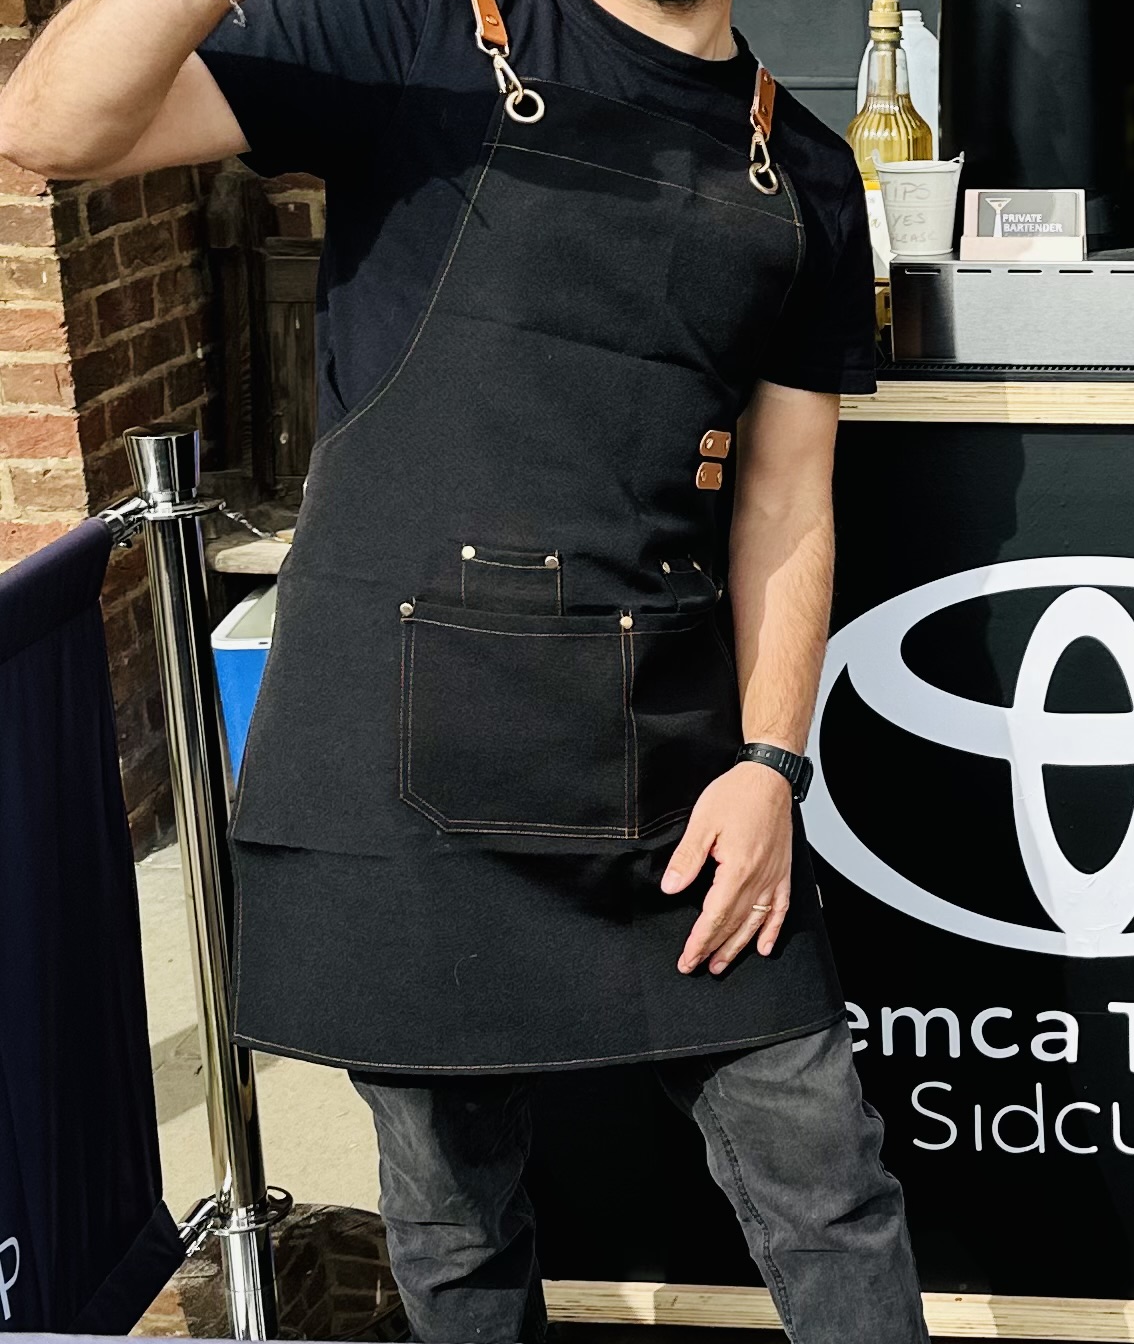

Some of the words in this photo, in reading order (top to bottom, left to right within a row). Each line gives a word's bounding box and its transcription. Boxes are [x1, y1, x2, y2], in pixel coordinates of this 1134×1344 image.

[881, 180, 931, 201] TIPS
[891, 212, 927, 227] YES
[1002, 213, 1043, 223] PRIVATE
[1003, 223, 1063, 233] BARTENDER
